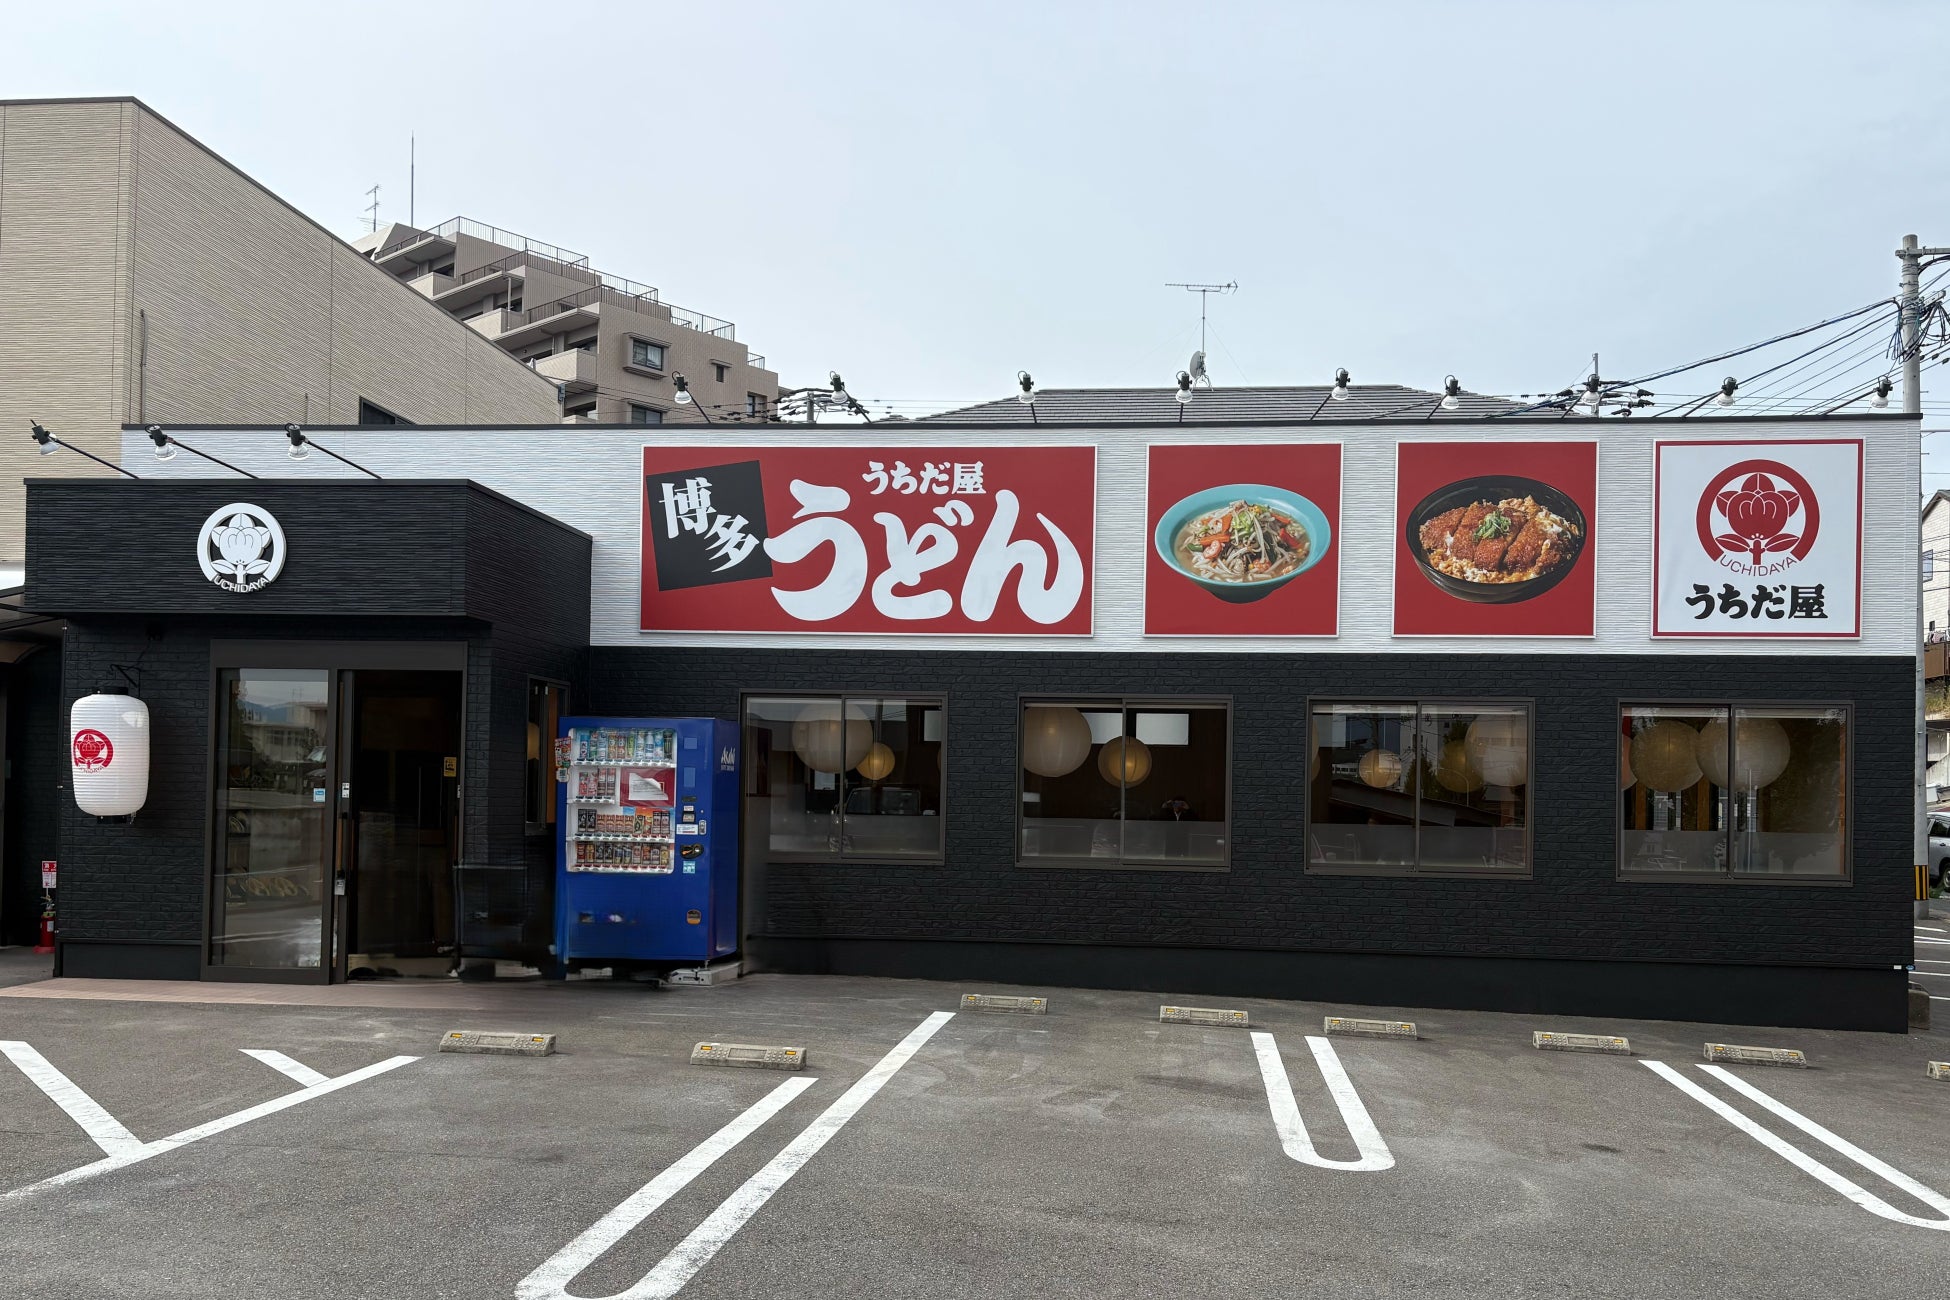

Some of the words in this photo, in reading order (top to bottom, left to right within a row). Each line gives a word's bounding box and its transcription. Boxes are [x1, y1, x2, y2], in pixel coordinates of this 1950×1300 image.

[861, 460, 987, 495] うちだ屋
[658, 476, 760, 573] 博多
[763, 478, 1085, 625] うどん
[1720, 554, 1797, 577] UCHIDAYA
[213, 575, 269, 593] UCHIDAYA
[1685, 583, 1829, 620] うちだ屋
